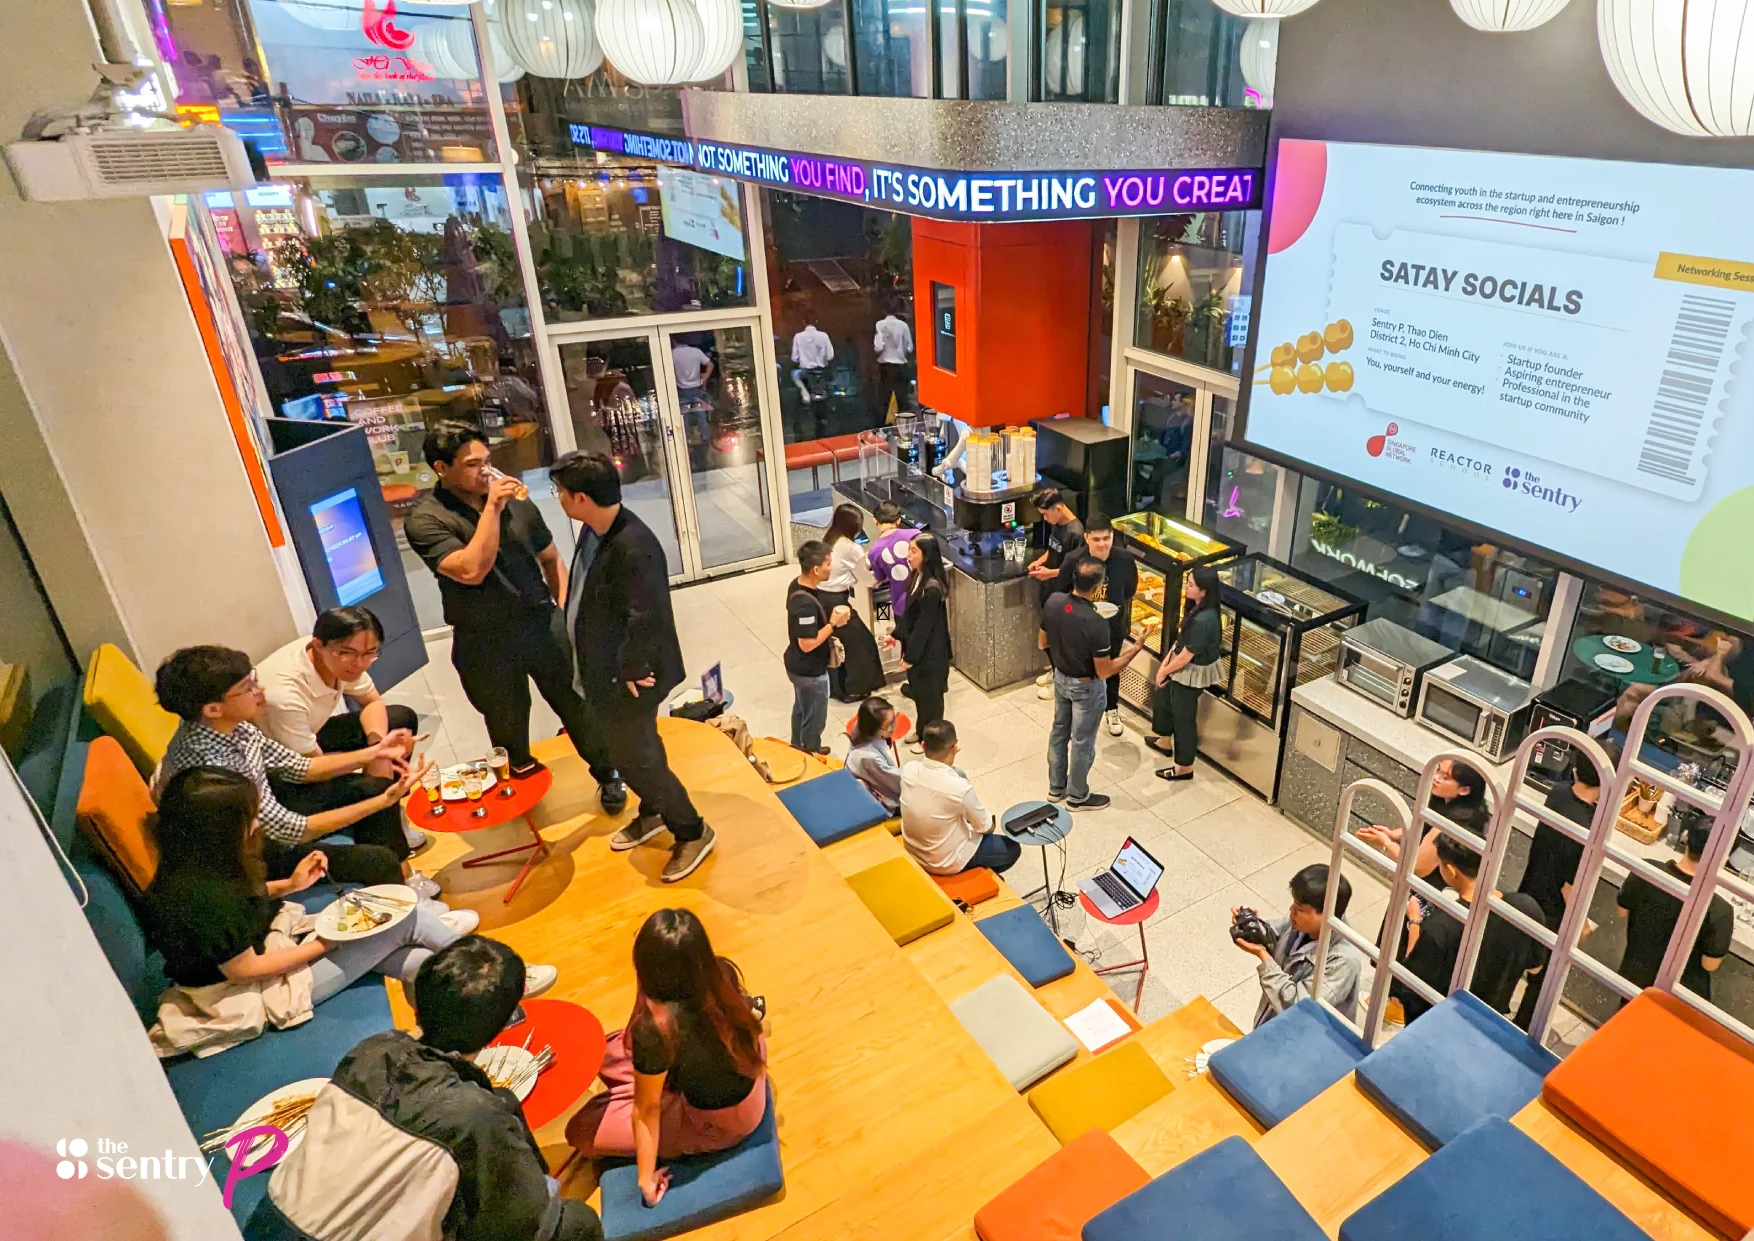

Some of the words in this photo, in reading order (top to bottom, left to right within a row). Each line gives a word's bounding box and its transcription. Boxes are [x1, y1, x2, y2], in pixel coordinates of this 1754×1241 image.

[717, 147, 789, 183] SOMETHING
[790, 157, 822, 188] YOU
[825, 162, 870, 202] FIND,
[872, 168, 903, 203] IT'S
[907, 174, 1097, 213] SOMETHING
[1103, 176, 1165, 207] YOU
[1410, 181, 1453, 195] Connecting
[1454, 184, 1478, 197] youth
[1479, 187, 1487, 198] in
[1489, 188, 1503, 199] the
[1505, 190, 1536, 204] startup
[1537, 193, 1555, 204] and
[1556, 195, 1640, 213] entrepreneurship
[1416, 196, 1456, 208] ecosystem
[1457, 200, 1483, 210] across
[1485, 201, 1498, 212] the
[1500, 204, 1528, 216] region
[1529, 206, 1551, 218] right
[1552, 209, 1573, 221] here
[1575, 211, 1584, 222] in
[1586, 212, 1619, 226] Saigon
[1676, 264, 1732, 281] Networking
[1380, 259, 1459, 292] SATAY
[1461, 273, 1584, 315] SOCIALS
[1371, 317, 1397, 332] Sentry
[1407, 324, 1426, 337] Thao
[1428, 329, 1448, 342] Dien
[1370, 329, 1398, 344] District
[1399, 336, 1407, 347] 2,
[1409, 338, 1421, 349] Ho
[1422, 341, 1437, 353] Chi
[1438, 344, 1460, 358] Minh
[1461, 350, 1481, 364] City
[1502, 341, 1517, 349] JOIN
[1534, 347, 1548, 356] YOU
[1548, 351, 1561, 359] ARE
[1366, 356, 1382, 370] You,
[1383, 362, 1415, 377] yourself
[1415, 369, 1431, 381] and
[1432, 374, 1451, 386] your
[1452, 379, 1486, 395] energy!
[1507, 354, 1542, 371] Startup
[1544, 362, 1584, 380] founder
[1502, 377, 1560, 400] Professional
[1561, 392, 1571, 404] in
[1573, 396, 1590, 408] the
[1504, 366, 1543, 386] Aspiring
[1545, 378, 1612, 400] entrepreneur
[354, 404, 404, 418] COFFEE
[358, 415, 386, 426] AND
[1499, 392, 1533, 409] startup
[1534, 401, 1590, 424] community
[367, 434, 396, 443] LUB
[1386, 445, 1406, 457] GLOBAL
[1387, 439, 1417, 454] SINGAPORE
[1385, 451, 1412, 465] NETWORK
[1430, 447, 1492, 475] REACTOR
[1524, 471, 1541, 484] the
[1521, 481, 1583, 513] sentry
